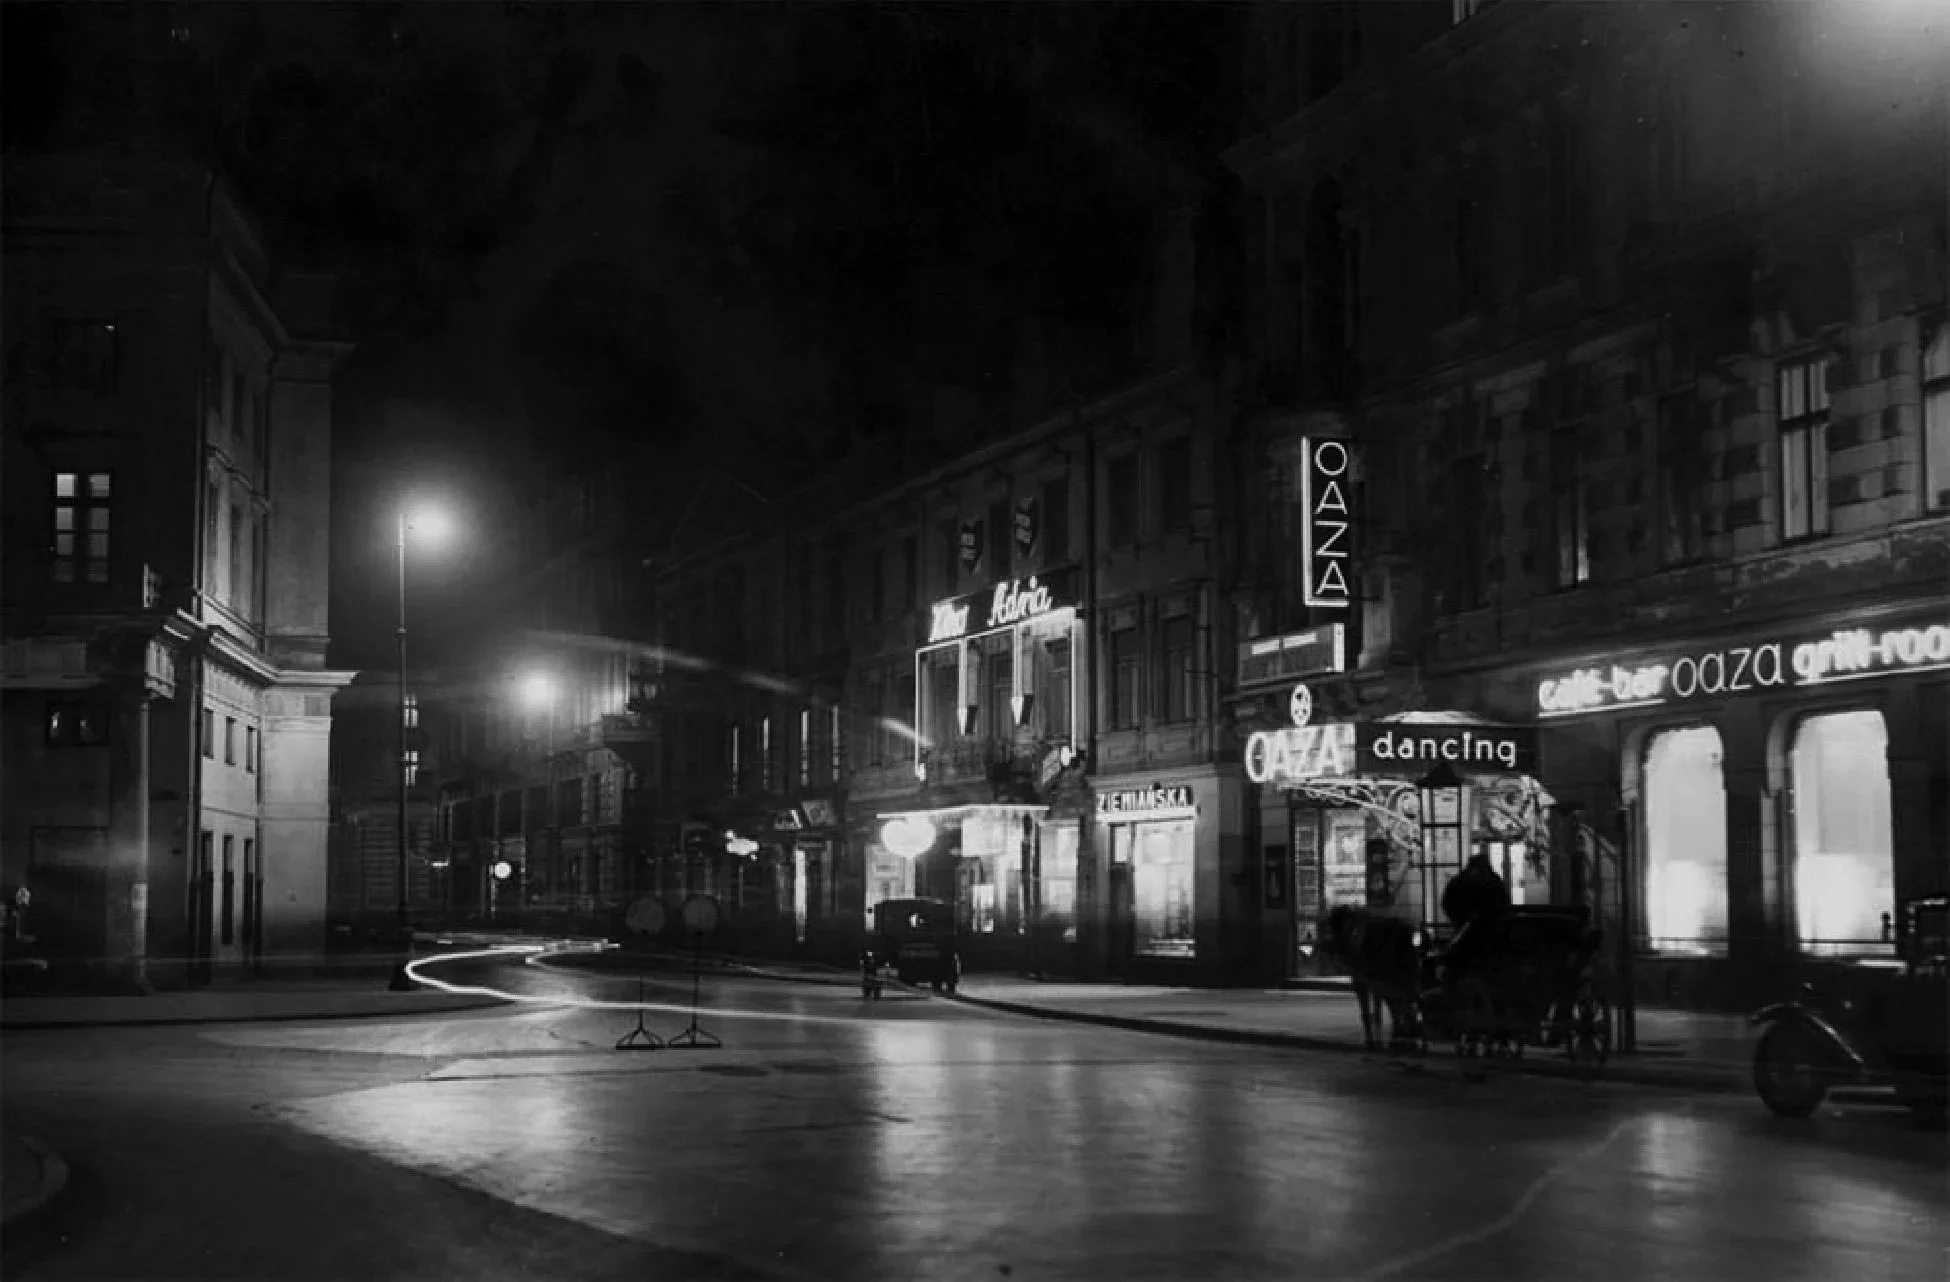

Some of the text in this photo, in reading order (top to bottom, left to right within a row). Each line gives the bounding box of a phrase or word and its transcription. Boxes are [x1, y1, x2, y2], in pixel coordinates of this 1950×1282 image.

[1314, 441, 1348, 595] OAZA
[987, 576, 1052, 627] Adria
[1672, 643, 1785, 697] oaza
[1792, 625, 1950, 682] grill-roo
[1246, 725, 1346, 782] OAZA
[1372, 731, 1517, 767] dancing
